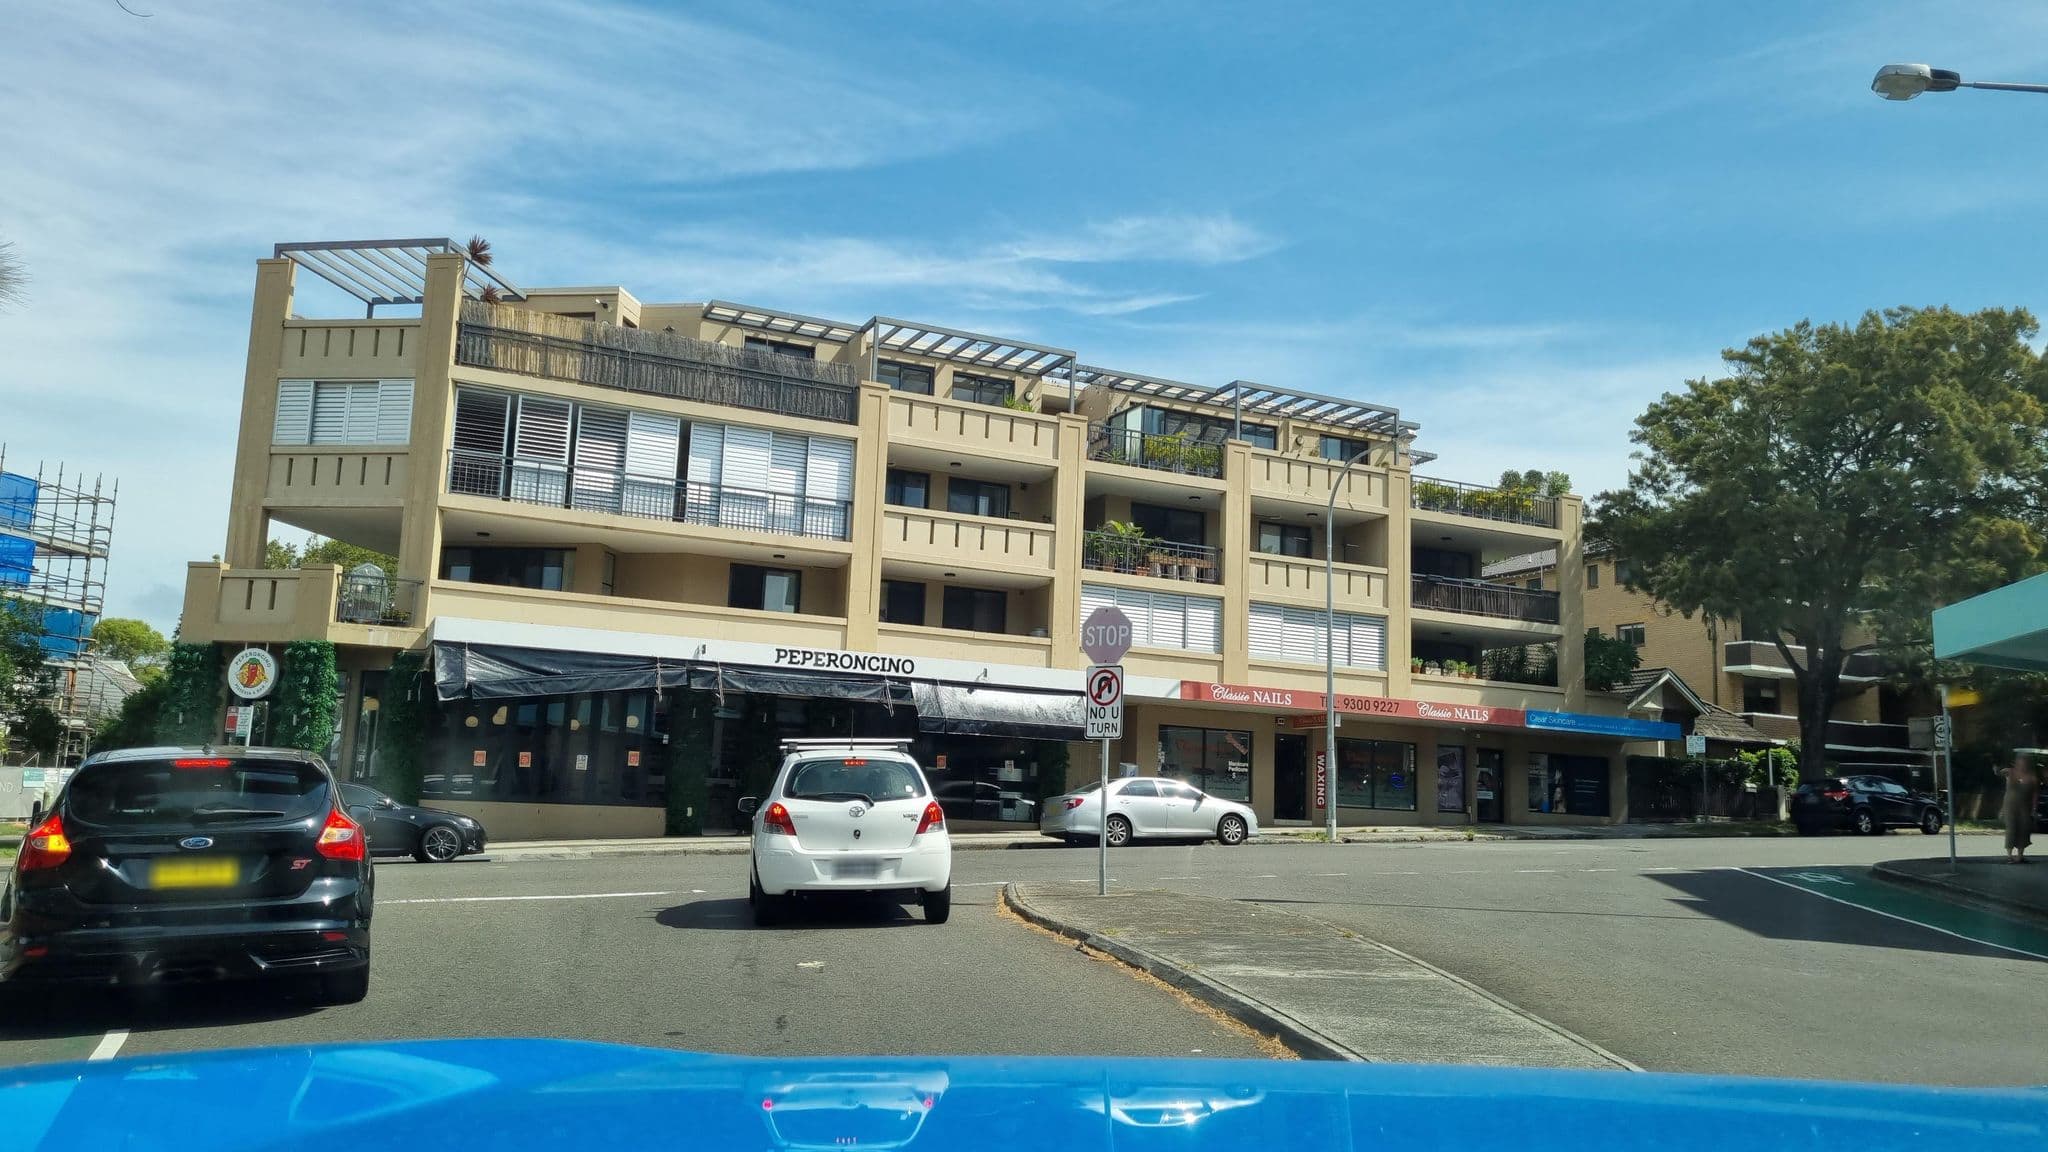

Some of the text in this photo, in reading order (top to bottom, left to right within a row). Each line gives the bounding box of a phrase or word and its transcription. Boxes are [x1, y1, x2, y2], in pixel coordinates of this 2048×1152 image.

[1085, 625, 1129, 646] STOP
[235, 652, 272, 668] PEPERONCINO
[775, 648, 915, 674] PEPERONCINO
[1211, 684, 1292, 706] Classic NAILS
[1090, 707, 1119, 719] NO U
[1320, 696, 1400, 713] TL: 9300 9227
[1416, 701, 1489, 721] Classic NAILS
[1091, 722, 1118, 733] TURN
[1548, 715, 1577, 727] Skincare
[1317, 754, 1325, 806] WAXING
[290, 859, 312, 870] ST
